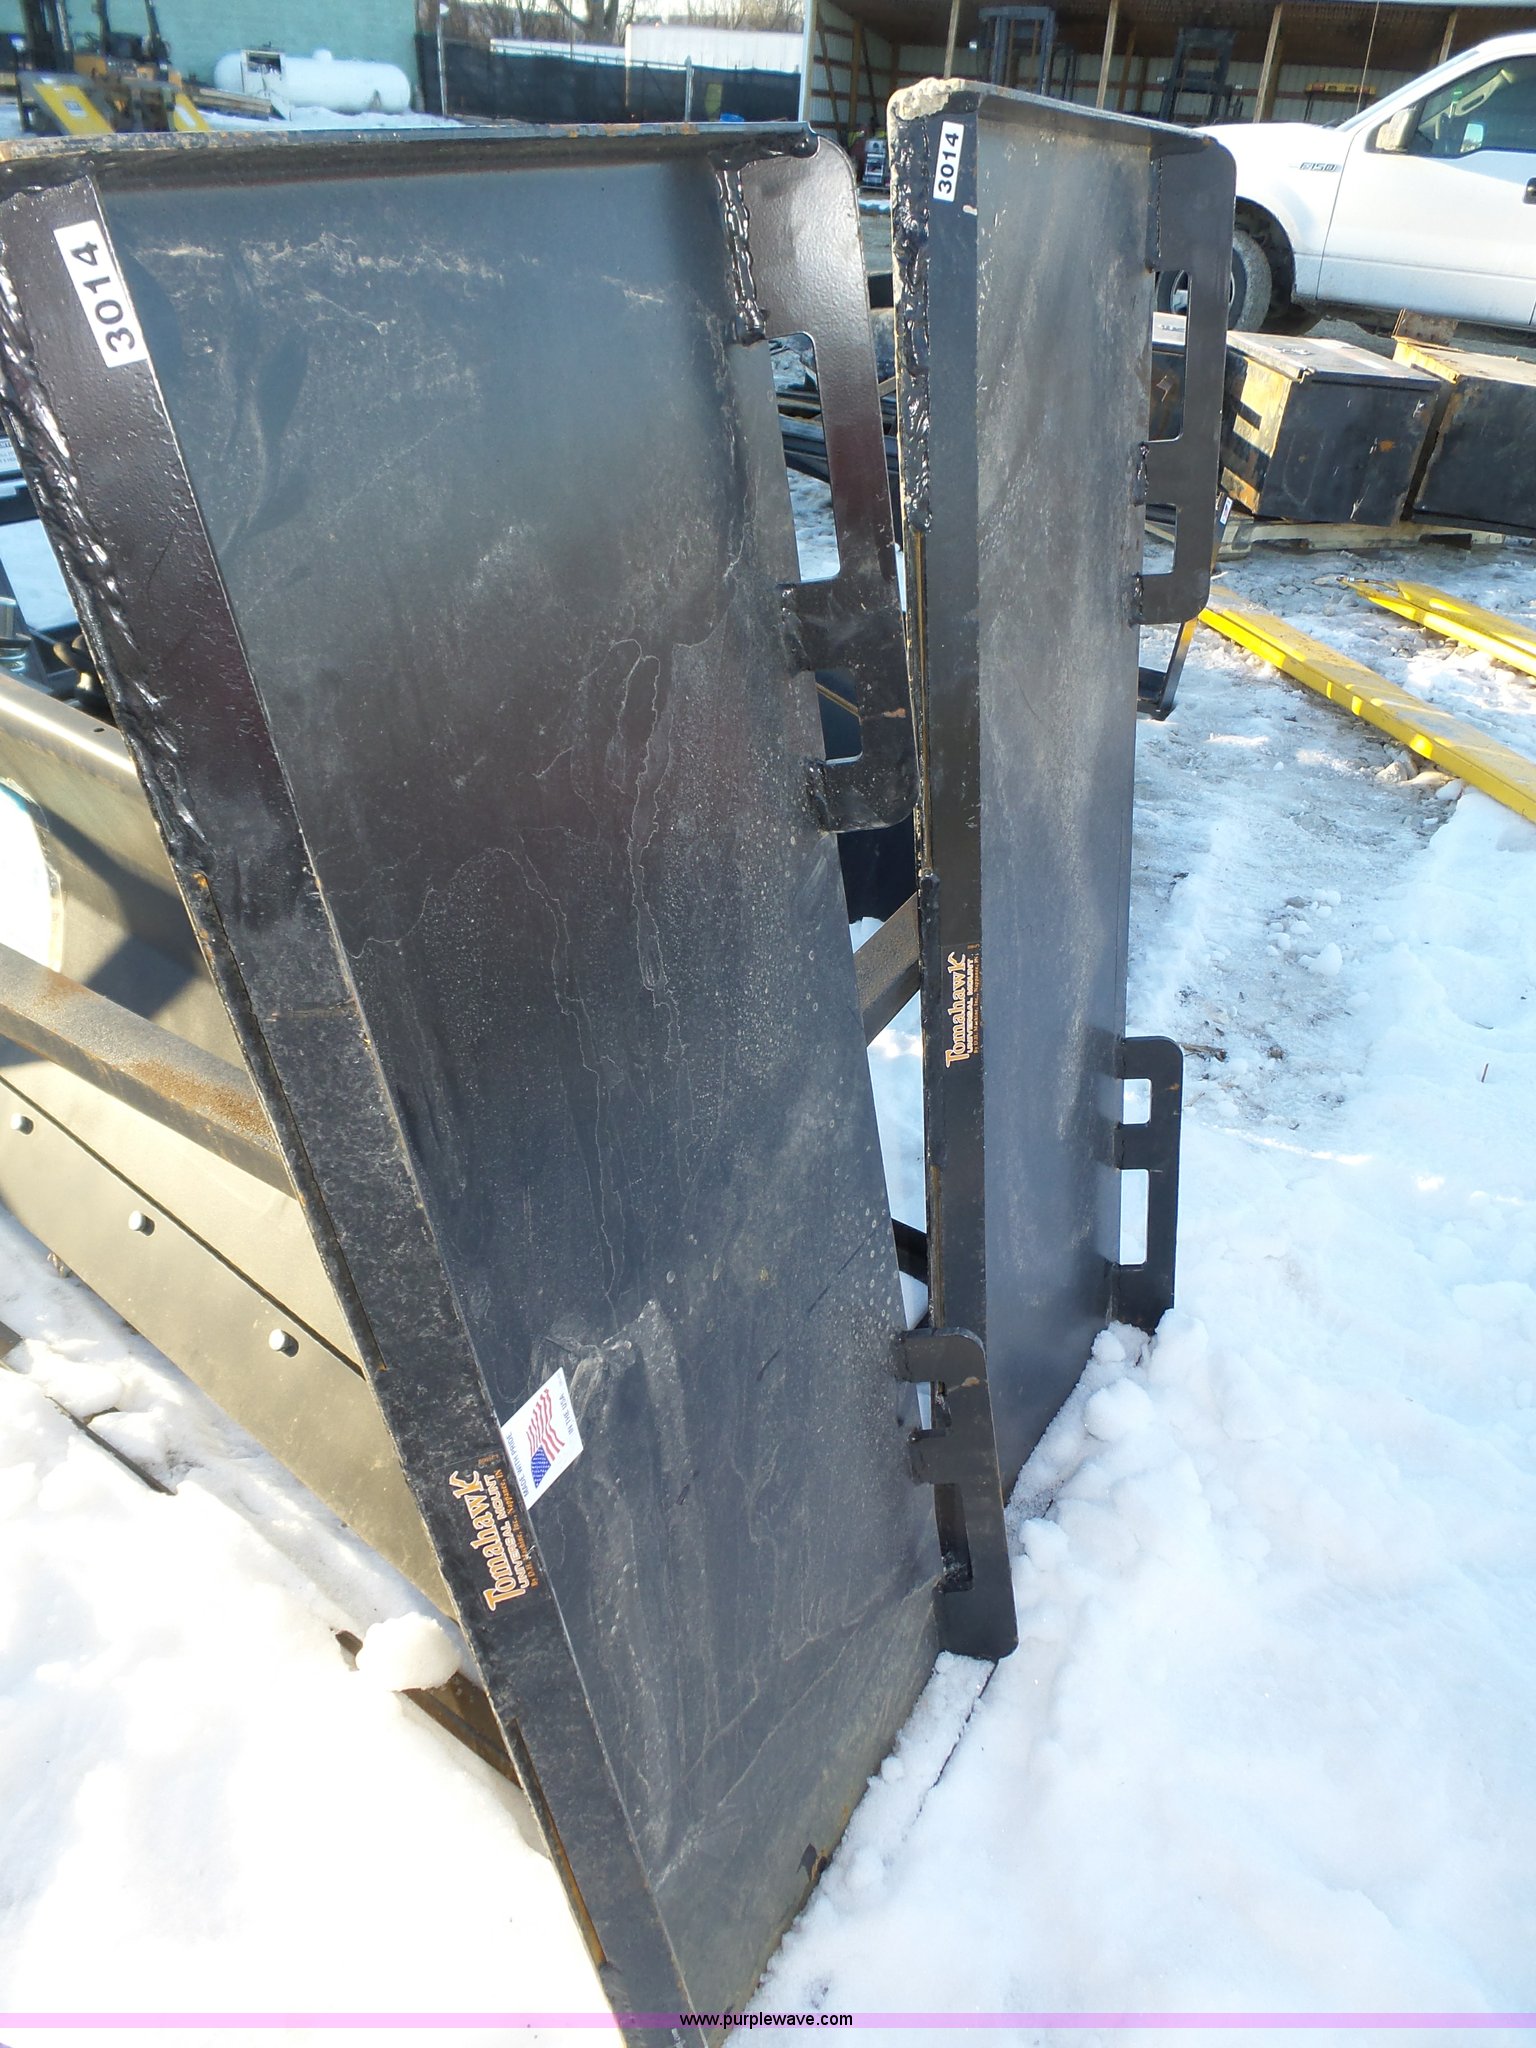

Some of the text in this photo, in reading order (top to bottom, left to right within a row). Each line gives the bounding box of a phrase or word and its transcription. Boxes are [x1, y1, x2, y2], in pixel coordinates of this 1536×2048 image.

[938, 133, 959, 194] 3014
[71, 241, 135, 353] 3014
[966, 958, 974, 995] MOUNT
[945, 951, 970, 1068] Tomahawk
[966, 997, 974, 1053] UNIVERSAL
[559, 1392, 567, 1410] USA
[563, 1409, 571, 1426] THE
[506, 1431, 529, 1497] MADE WITH PRIDE
[483, 1474, 507, 1520] MOUNT
[449, 1470, 526, 1611] Tomahawk
[500, 1520, 530, 1589] UNIVERSAL
